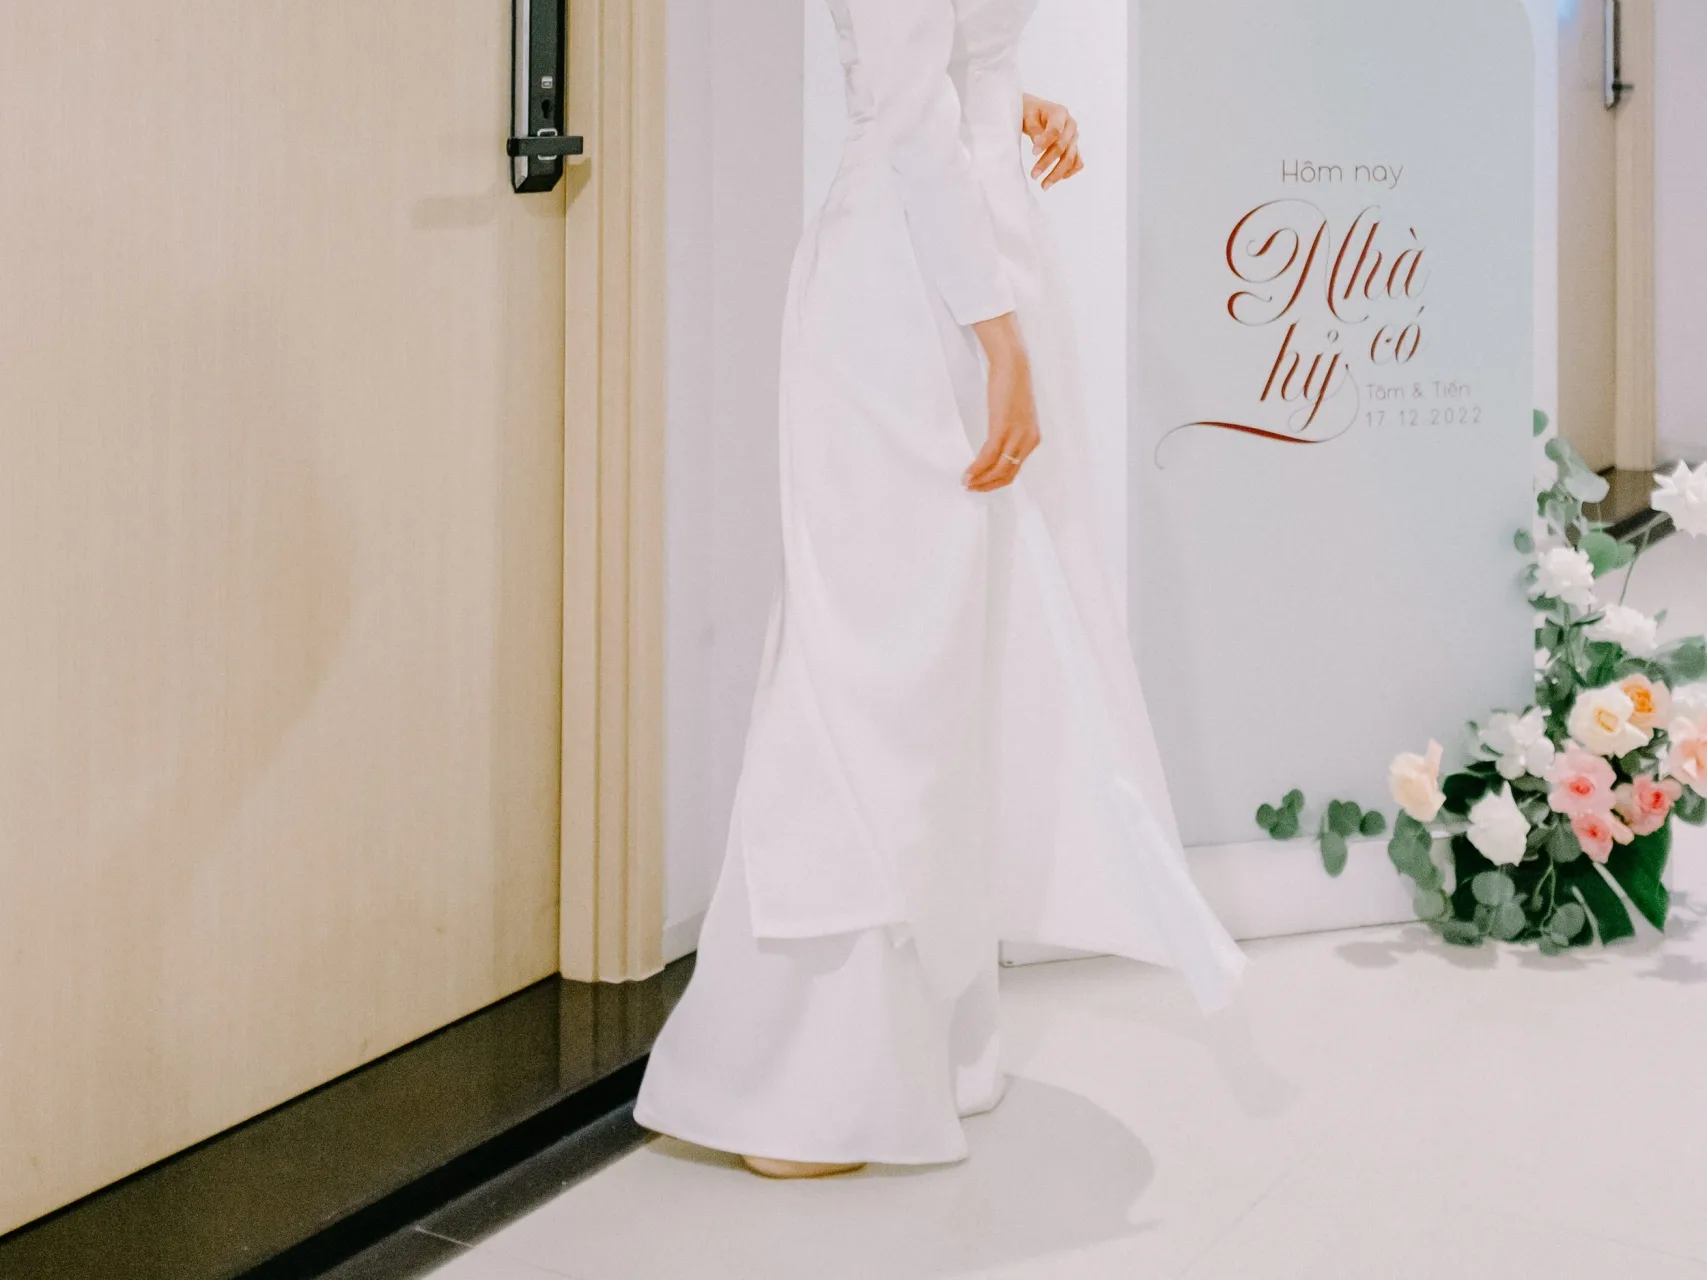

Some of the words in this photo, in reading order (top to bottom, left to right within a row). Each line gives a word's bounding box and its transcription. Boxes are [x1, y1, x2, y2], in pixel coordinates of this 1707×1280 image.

[1281, 158, 1343, 184] Hôm
[1354, 162, 1404, 190] nay
[1226, 197, 1431, 326] Nhà
[1369, 305, 1426, 366] có
[1412, 381, 1424, 399] &
